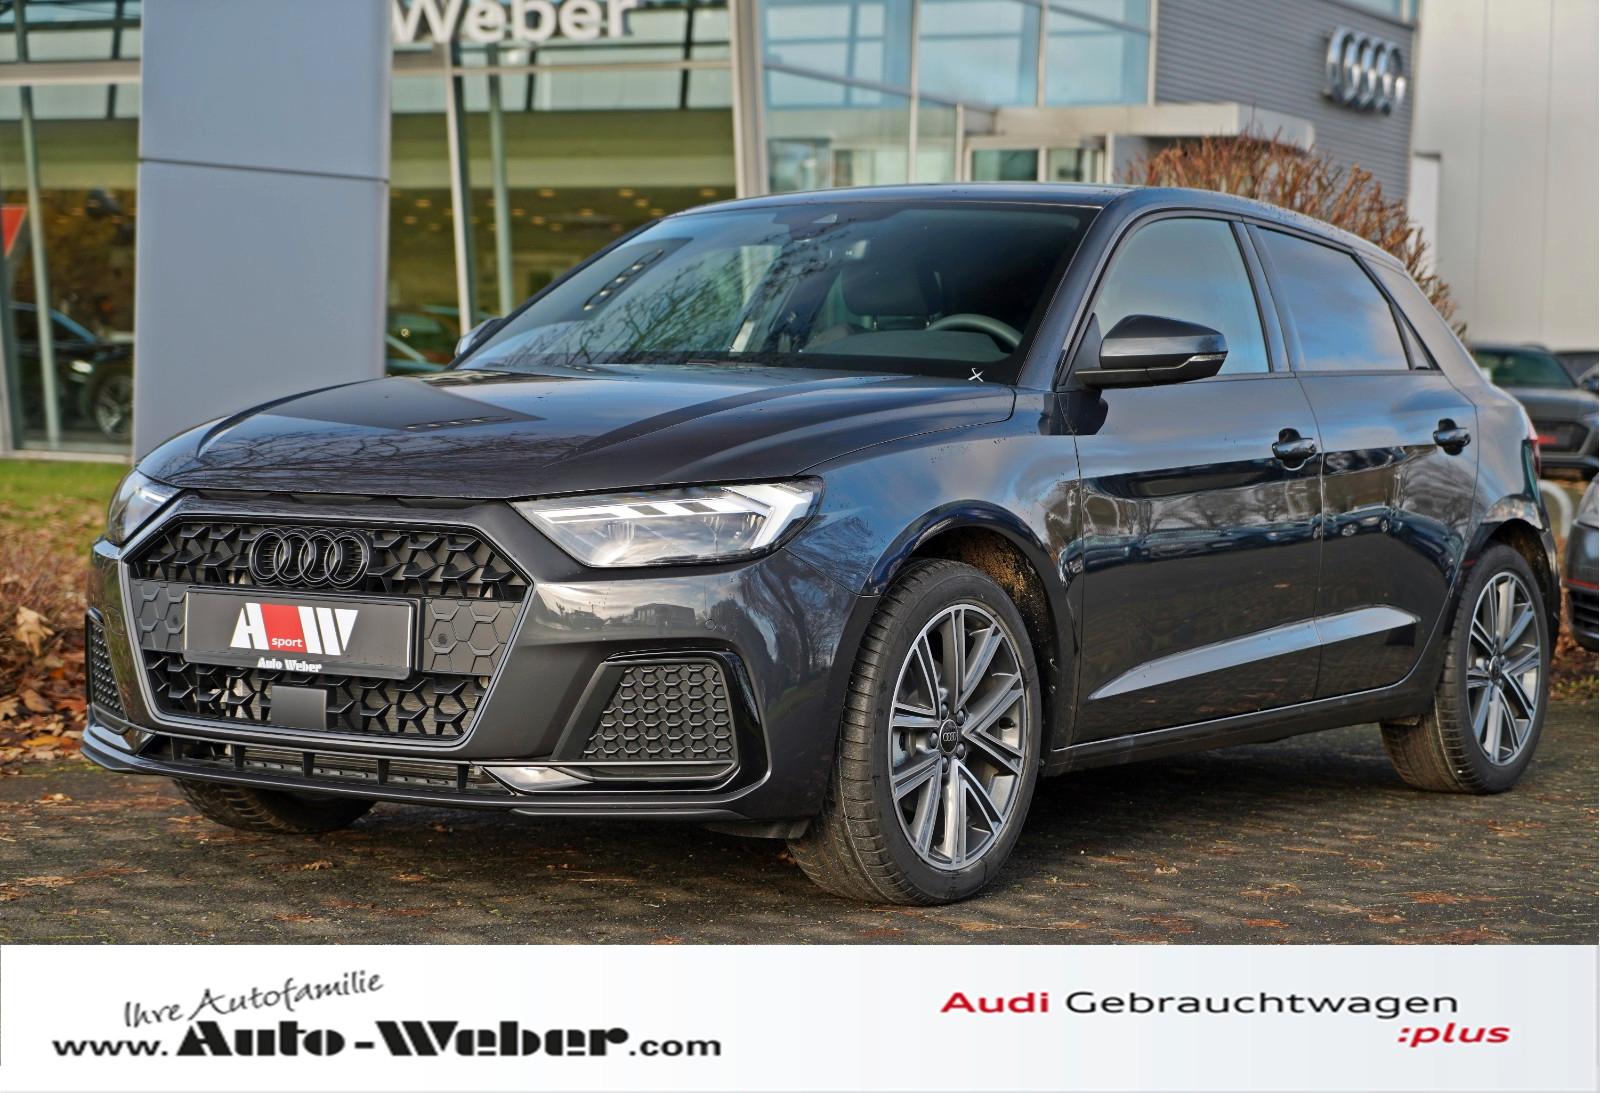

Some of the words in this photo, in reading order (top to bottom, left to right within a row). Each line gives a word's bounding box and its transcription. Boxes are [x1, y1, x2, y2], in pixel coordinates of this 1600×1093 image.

[393, 0, 636, 43] Weber
[271, 637, 303, 648] sport
[285, 659, 322, 673] Weber
